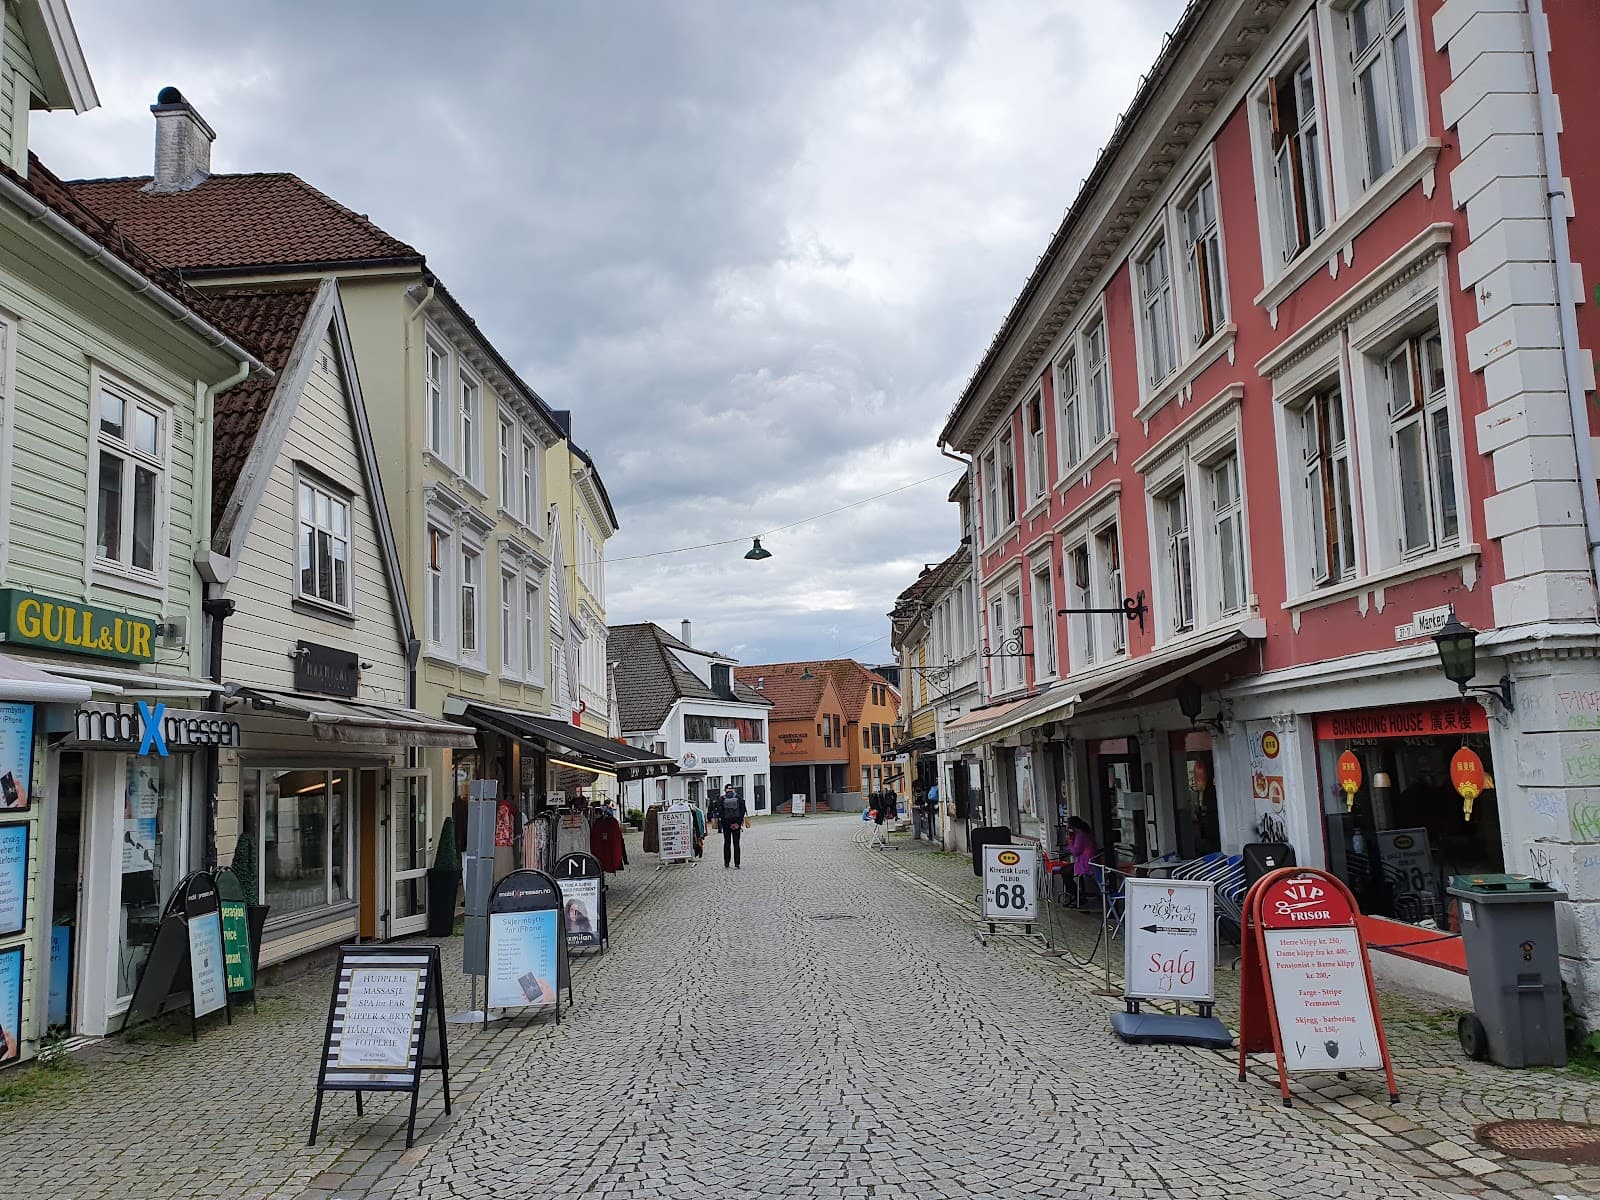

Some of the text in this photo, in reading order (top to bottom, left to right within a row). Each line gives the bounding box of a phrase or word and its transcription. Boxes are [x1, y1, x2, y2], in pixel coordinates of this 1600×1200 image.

[1419, 613, 1447, 630] Marken
[16, 599, 151, 657] GULL&UR
[1333, 713, 1424, 735] GUANGDONG HOUSE
[1284, 885, 1324, 901] VIP
[1290, 911, 1331, 921] FRISØR
[1300, 938, 1318, 947] klipp
[1297, 950, 1314, 958] klipp
[1149, 949, 1196, 984] Salg
[1276, 962, 1310, 970] Pensjonist
[1337, 960, 1355, 969] klipp
[363, 975, 408, 983] HUDPLEIE
[363, 988, 405, 996] MASSASJE
[1322, 989, 1342, 997] Stripe
[389, 1012, 413, 1020] BRYN
[1296, 1017, 1319, 1025] Skjegg
[1323, 1016, 1357, 1024] barbering
[355, 1039, 398, 1047] FOTPLEIE
